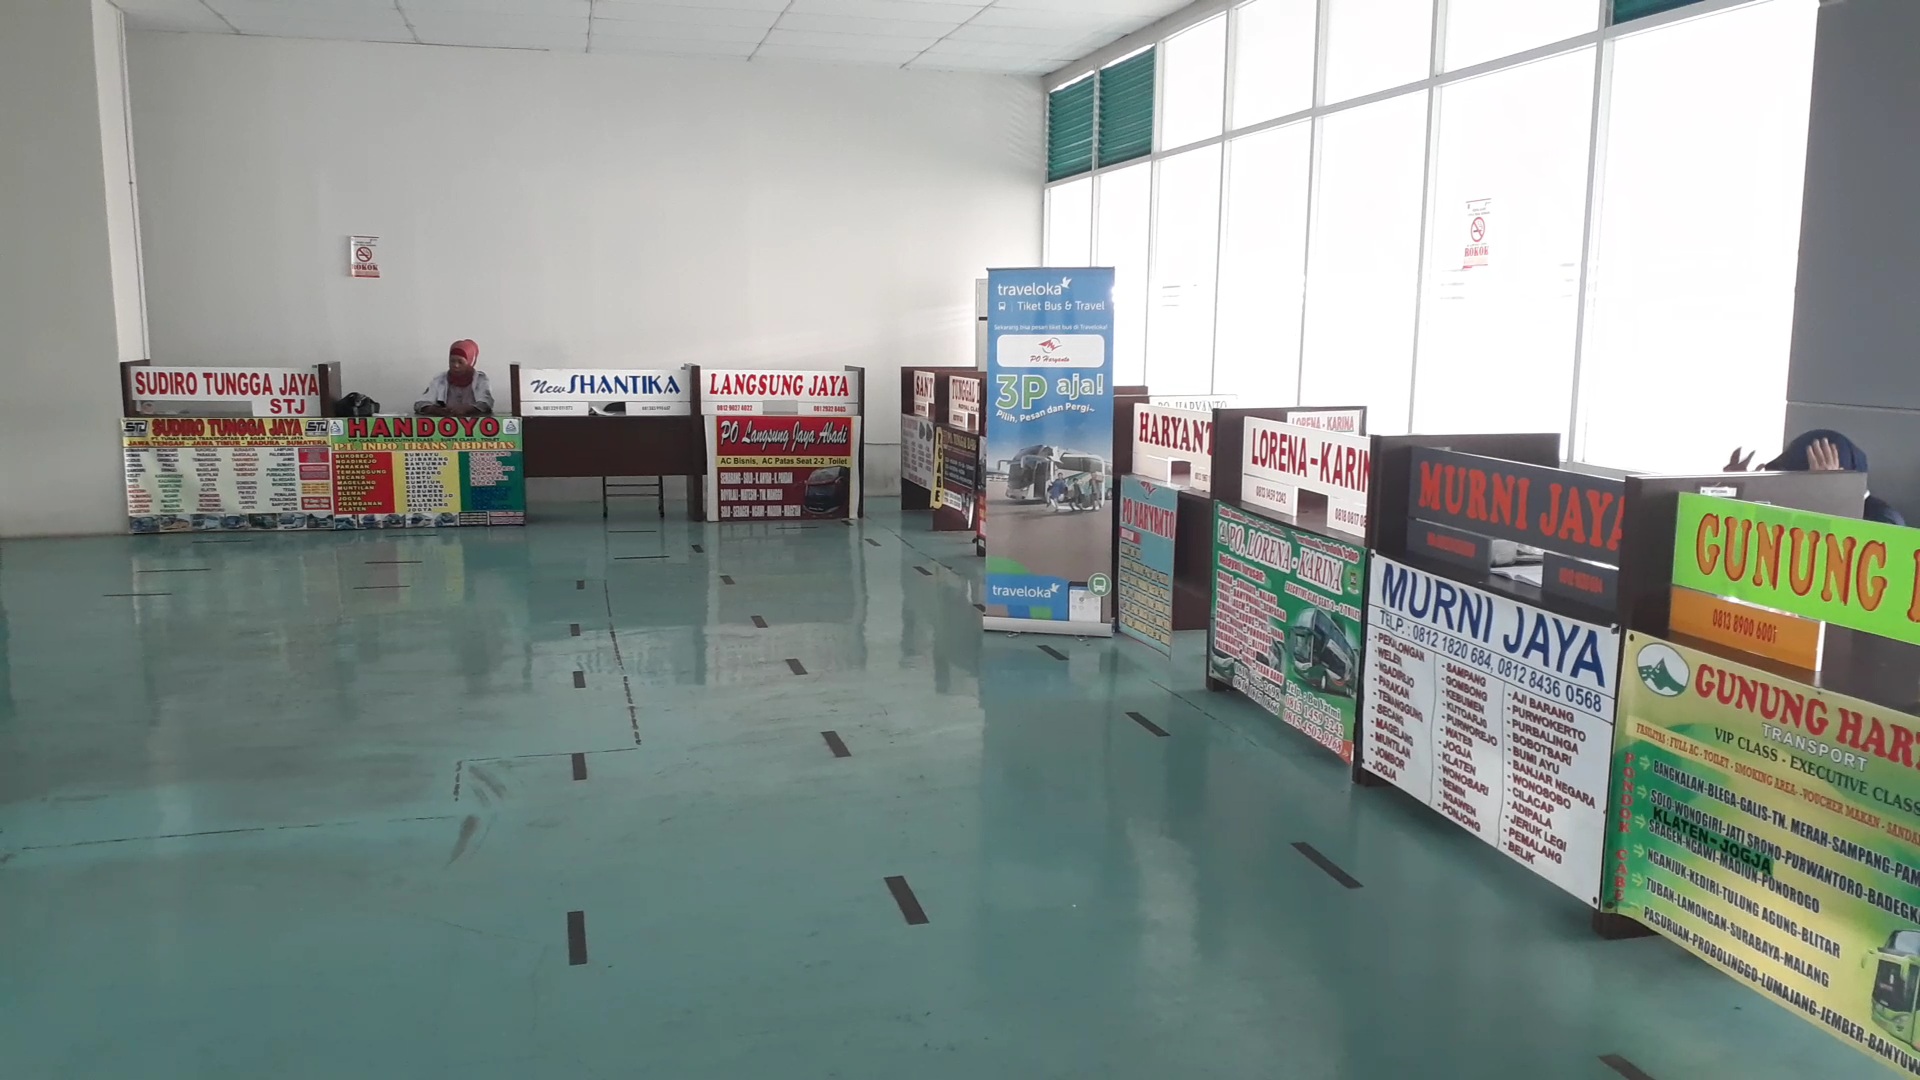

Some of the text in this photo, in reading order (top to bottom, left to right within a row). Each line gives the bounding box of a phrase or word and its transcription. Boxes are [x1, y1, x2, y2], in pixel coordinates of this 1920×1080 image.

[997, 282, 1062, 296] traveloka
[1017, 301, 1105, 311] Tiket Bus & Travel
[994, 324, 1019, 332] Sekarang
[1042, 355, 1070, 363] Haryanto
[135, 371, 320, 396] SUDIRO TUNGGA JAYA
[530, 374, 681, 394] New SHANTIKA
[710, 373, 850, 397] LANGSUNG JAYA
[995, 373, 1104, 410] 3P aja!
[270, 398, 306, 414] STJ
[996, 409, 1018, 424] Pilih,
[1020, 409, 1046, 422] Pesan
[1047, 403, 1064, 414] dan
[152, 418, 205, 437] SUDIRO
[208, 418, 266, 436] TUNGGA
[269, 418, 303, 436] JAYA
[348, 418, 500, 438] HANDOYO
[720, 420, 848, 452] PO Langsung Jaya Abadi
[334, 442, 516, 450] PT. INDO TRANS ABDIMAS
[734, 458, 758, 466] Bisnis,
[1418, 460, 1530, 531] MURNI
[1122, 497, 1134, 525] PO
[1247, 529, 1292, 574] LORENA
[1298, 548, 1343, 594] KARINA
[1696, 512, 1888, 612] GUNUNG
[992, 584, 1052, 598] traveloka
[1382, 562, 1494, 644] MURNI
[1502, 606, 1606, 688] JAYA
[1712, 608, 1731, 630] 0813
[1733, 613, 1754, 637] 8900
[1412, 624, 1439, 648] 0812
[1442, 635, 1468, 660] 1820
[1471, 647, 1494, 674] 684,
[1498, 658, 1528, 684] 0812
[1528, 670, 1560, 698] 8436
[1566, 684, 1602, 712] 0568
[1446, 662, 1486, 688] SAMPANG
[1378, 676, 1410, 700] PARAKAN
[1446, 676, 1488, 702] GOMBONG
[1446, 688, 1484, 714] KEBUMEN
[1695, 664, 1829, 736] GUNUNG
[1376, 704, 1404, 726] SECANG
[1446, 701, 1487, 728] KUTOARJO
[1512, 691, 1574, 724] AJI BARANG
[1376, 717, 1414, 746] MAGELANG
[1445, 726, 1474, 748] WATES
[1446, 714, 1498, 746] PURWOREJO
[1512, 704, 1586, 742] PURWOKERTO
[1512, 718, 1580, 755] PURBALINGA
[1374, 746, 1405, 771] JOMBOR
[1375, 732, 1411, 759] MUNTILAN
[1443, 740, 1472, 760] JOGJA
[1512, 732, 1572, 766] BOBOTSARI
[1762, 722, 1868, 773] TRANSPORT
[1372, 760, 1396, 782] JOGJA
[1442, 752, 1476, 776] KLATEN
[1512, 746, 1560, 775] BUMI AYU
[1714, 726, 1734, 746] VIP
[1737, 736, 1778, 764] CLASS
[1789, 757, 1869, 798] EXECUTIVE
[1442, 764, 1489, 796] WONOSARI
[1512, 760, 1596, 809] BANJAR NEGARA
[1512, 772, 1572, 810] WONOSOBO
[1670, 738, 1688, 753] FULL
[1688, 743, 1700, 757] AC
[1703, 750, 1730, 770] TOILET
[1734, 762, 1773, 786] SMOKING
[1845, 805, 1881, 829] MAKAN
[1512, 786, 1555, 814] CILACAP
[1442, 802, 1481, 832] PONJONG
[1512, 800, 1553, 830] ADIPALA
[1508, 827, 1562, 865] PEMALANG
[1510, 814, 1567, 853] JERUK LEGI
[1653, 806, 1773, 876] KLATEN JOGJA
[1508, 840, 1536, 864] BELIK
[1761, 908, 1841, 960] AGUNG-BLITAR
